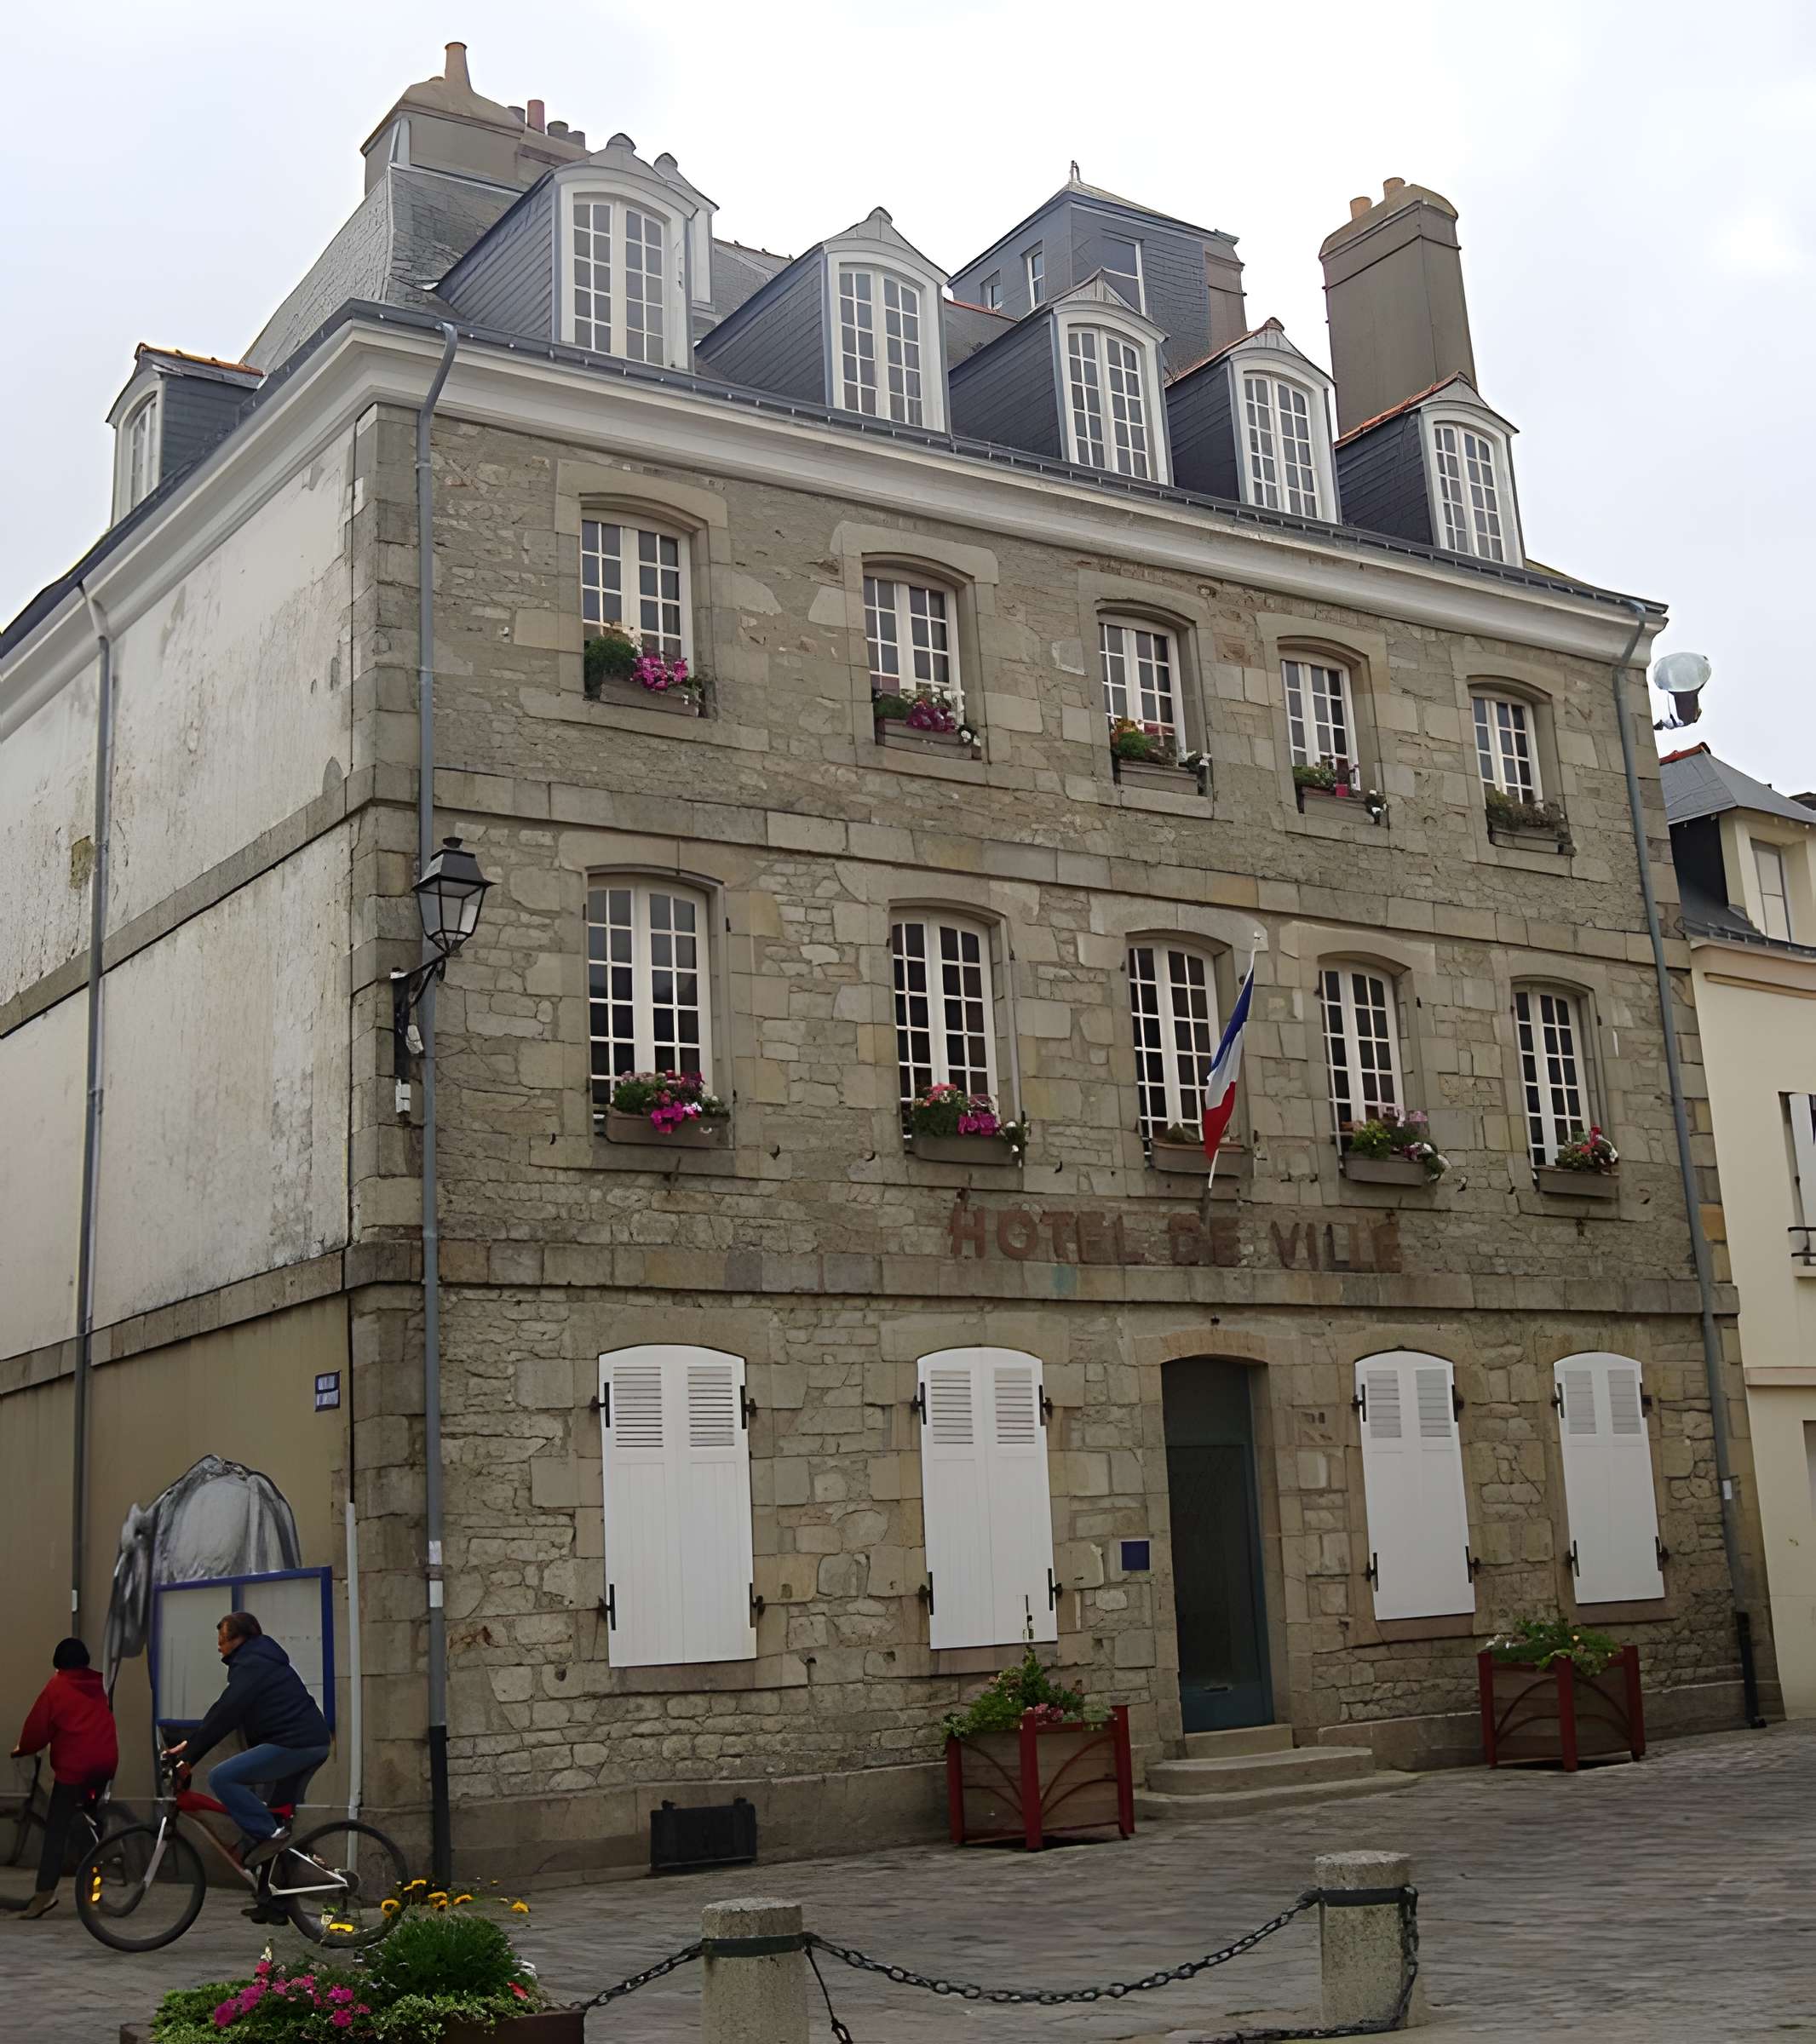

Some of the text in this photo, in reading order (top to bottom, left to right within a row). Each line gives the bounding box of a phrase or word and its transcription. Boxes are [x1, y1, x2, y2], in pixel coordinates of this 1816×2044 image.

[949, 1205, 1401, 1272] HOTEL DE VILLE
